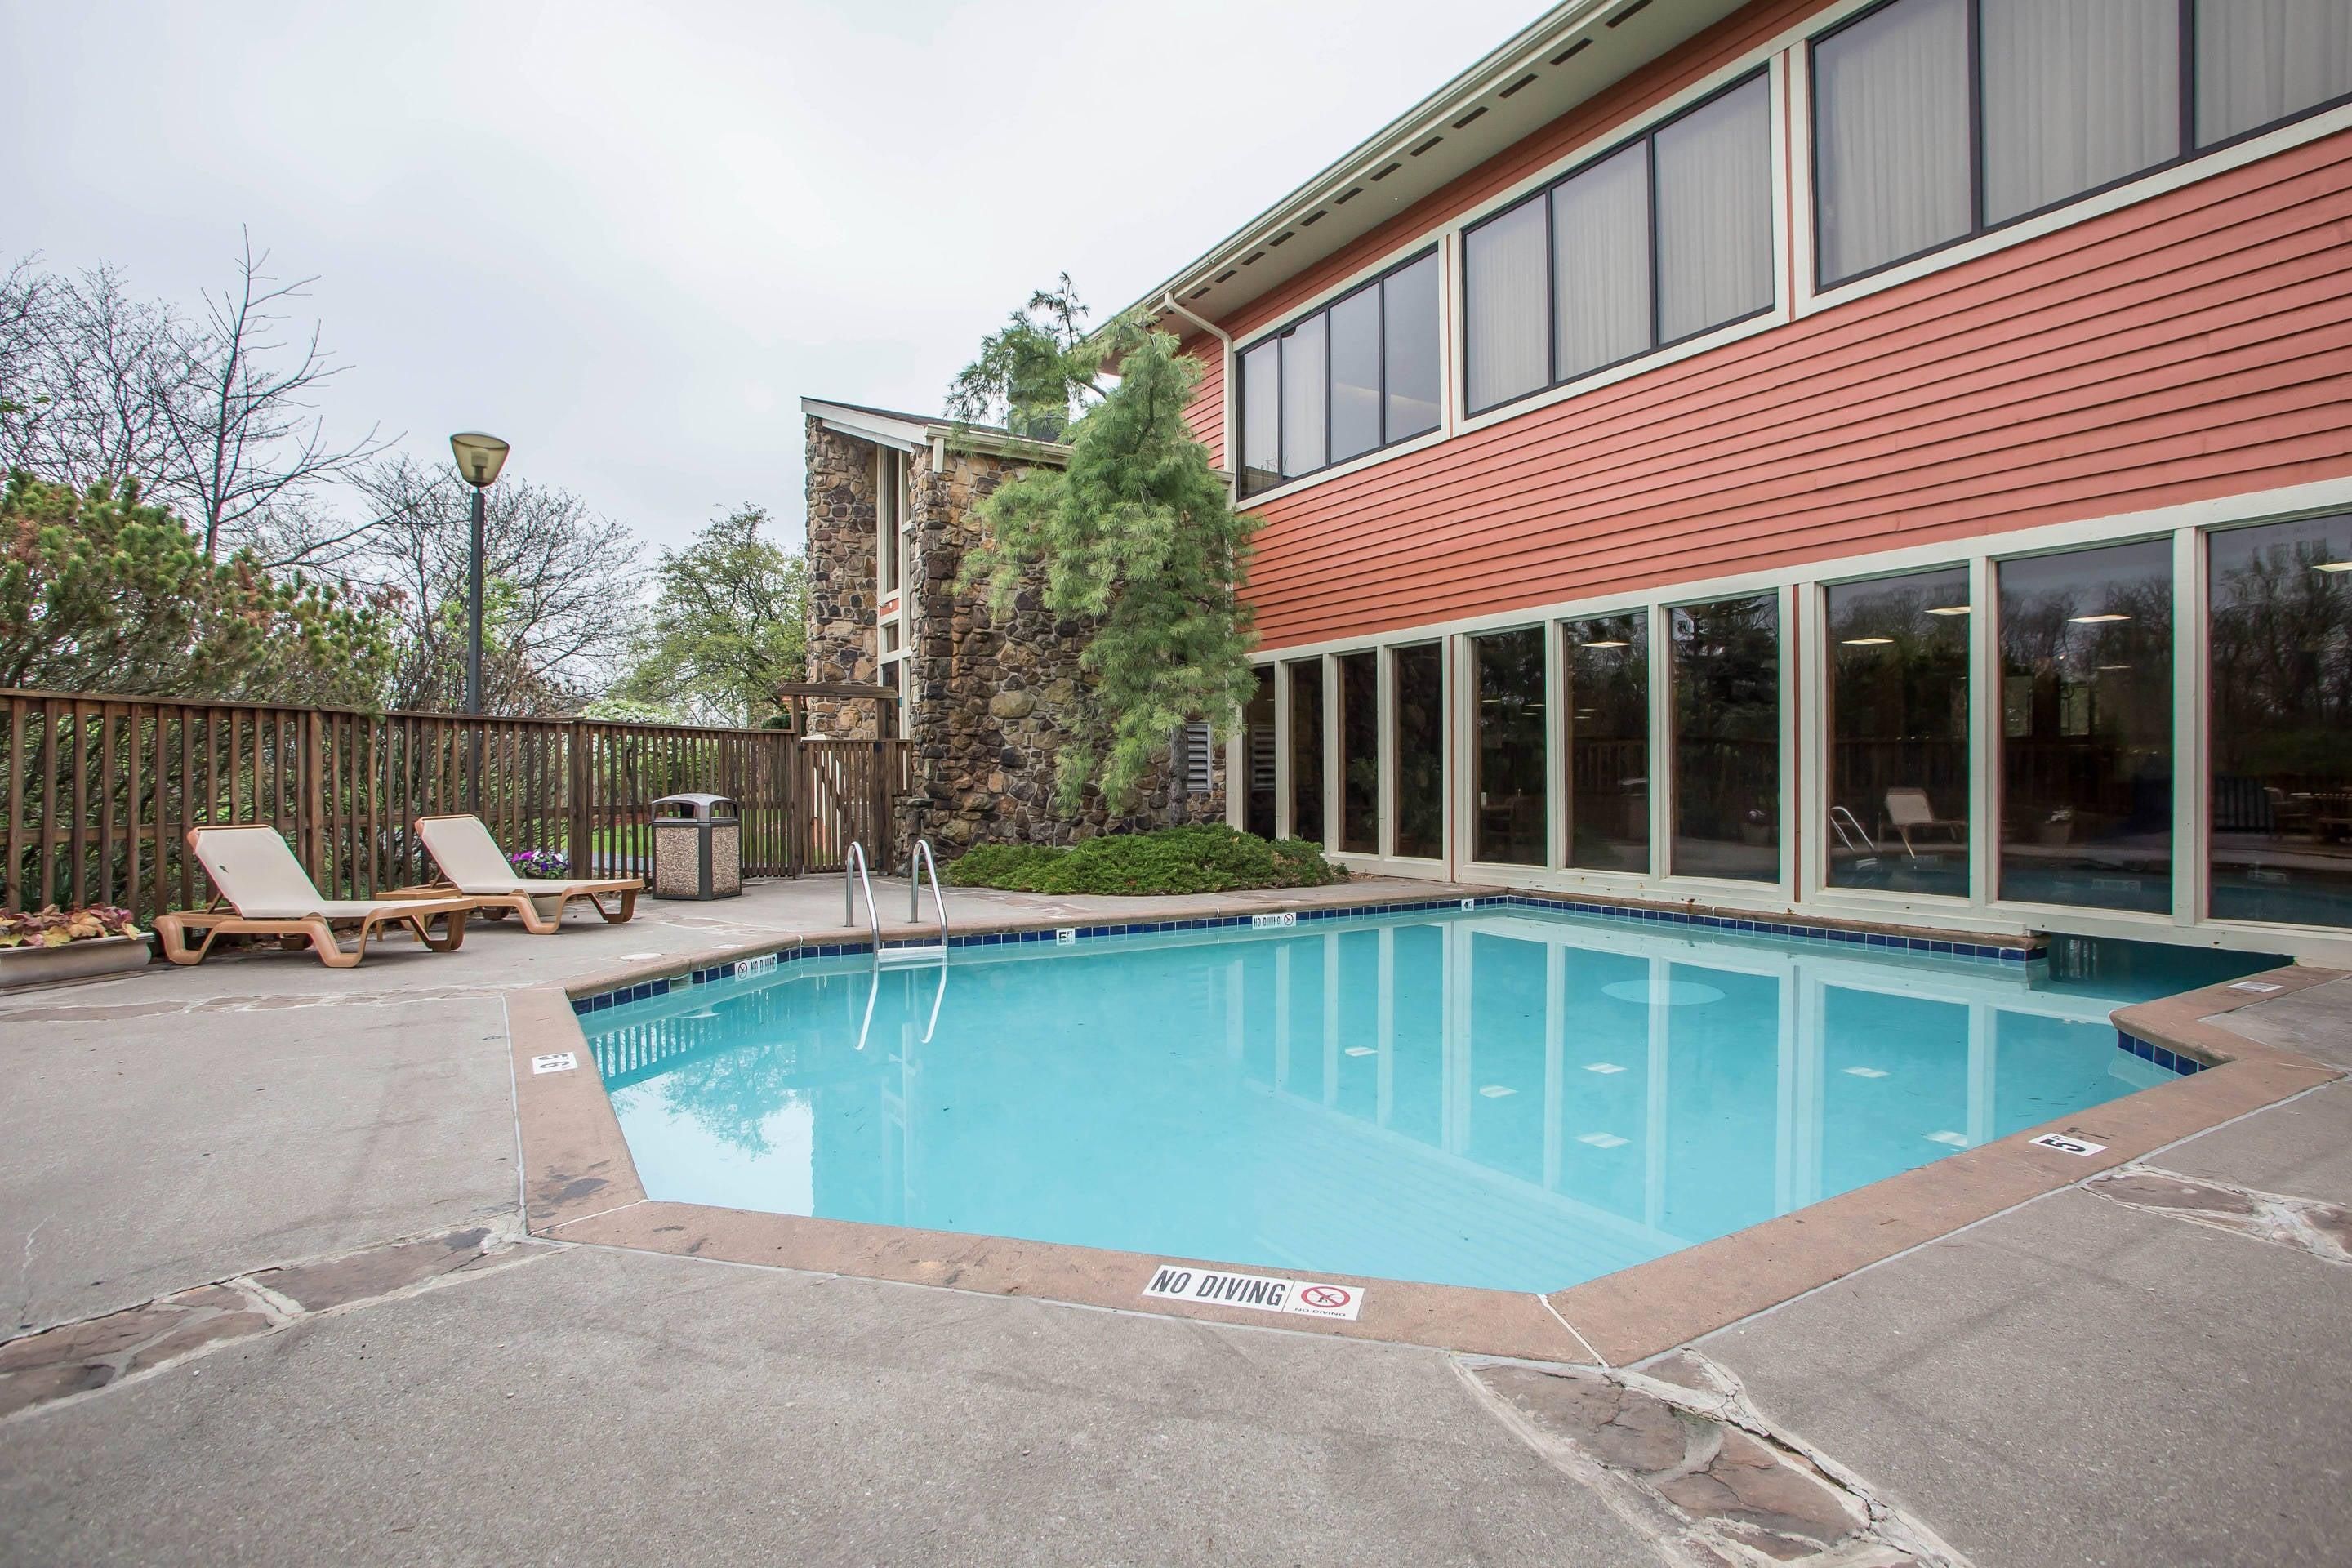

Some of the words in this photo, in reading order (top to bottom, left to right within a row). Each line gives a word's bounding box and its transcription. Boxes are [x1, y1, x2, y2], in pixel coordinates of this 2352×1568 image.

[2040, 1138, 2087, 1152] 5
[1151, 1270, 1192, 1294] NO
[1196, 1275, 1285, 1307] DIVING
[1318, 1309, 1347, 1317] DIVING
